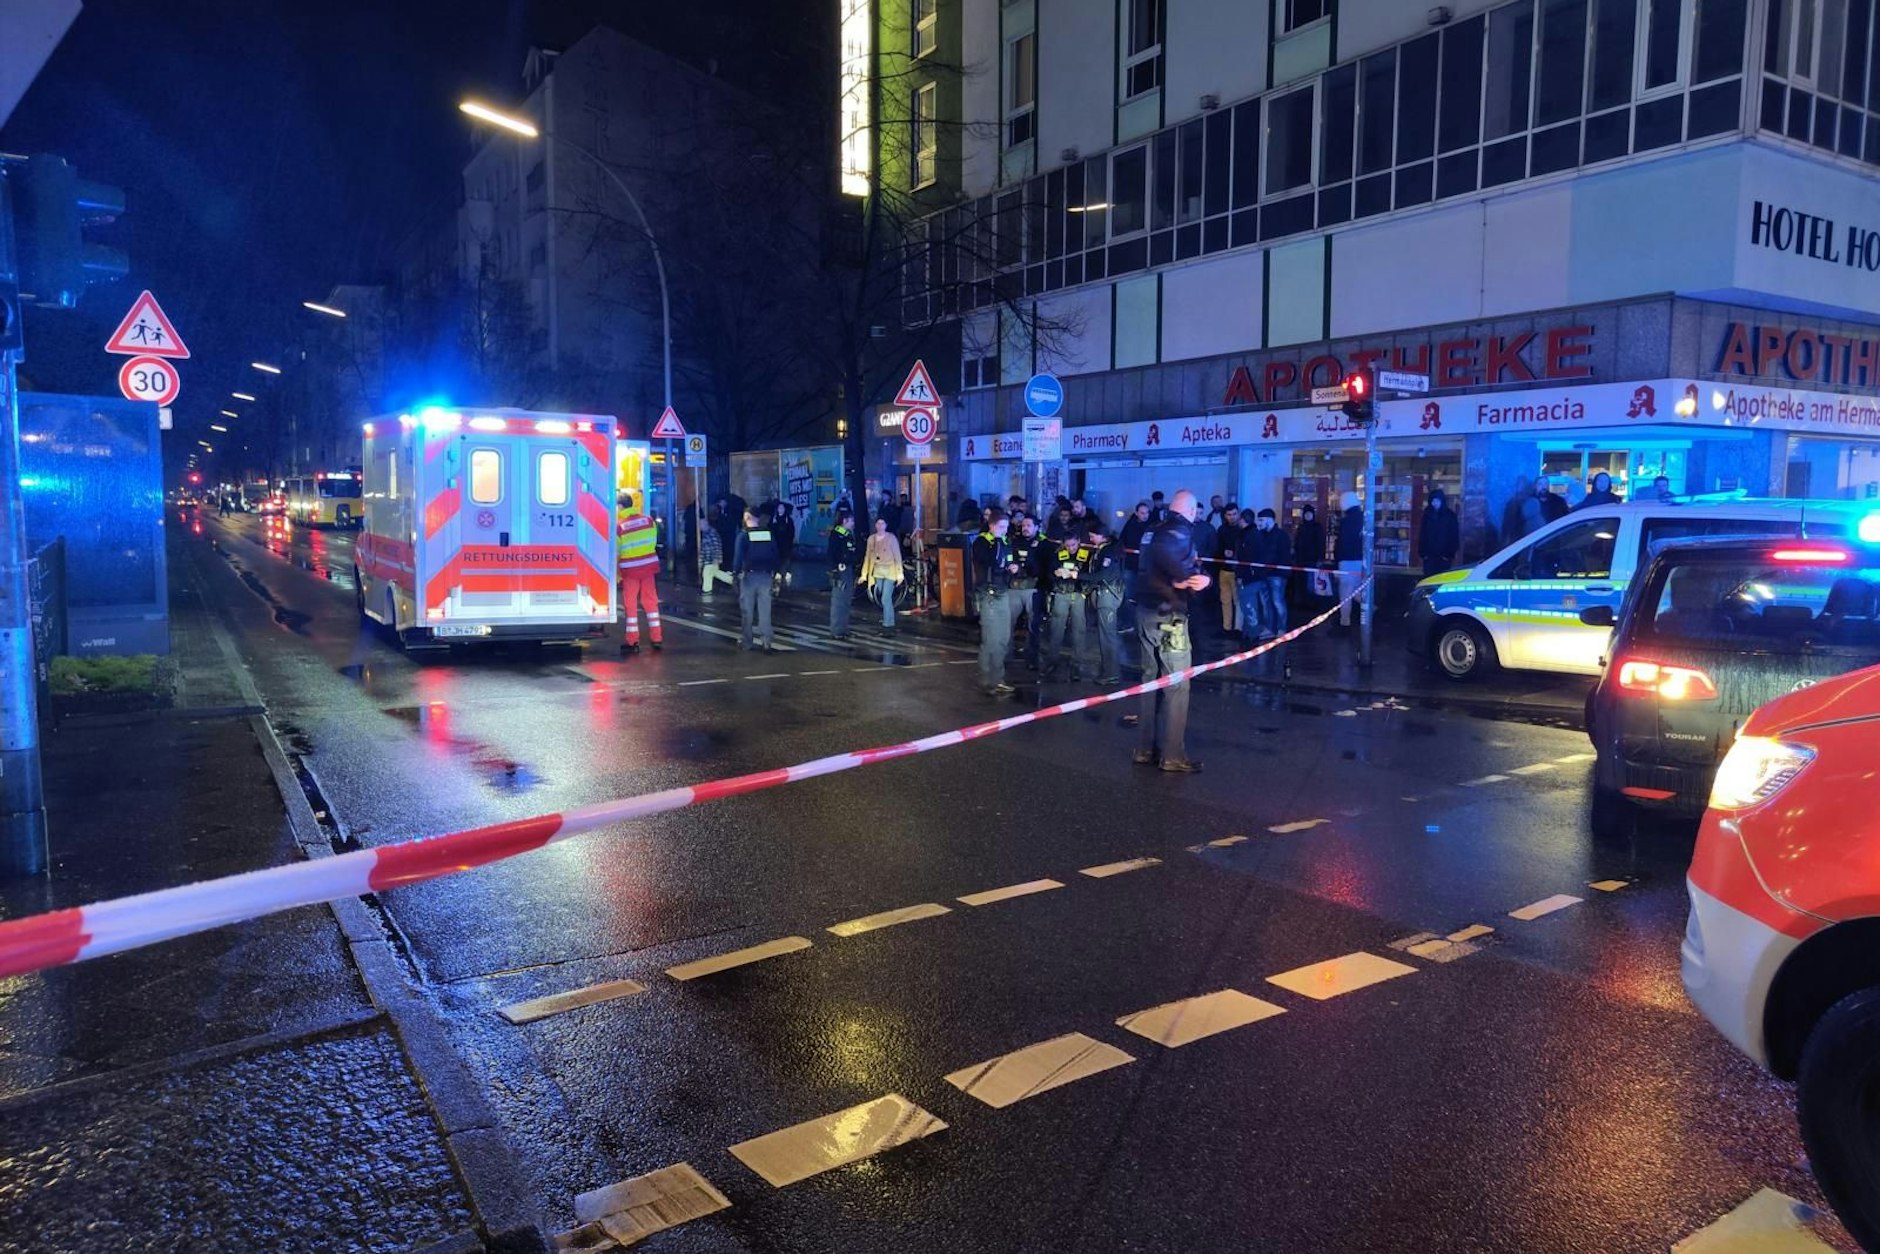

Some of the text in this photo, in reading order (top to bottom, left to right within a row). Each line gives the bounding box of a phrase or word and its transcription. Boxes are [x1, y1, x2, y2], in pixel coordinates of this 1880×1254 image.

[1751, 200, 1840, 264] HOTEL
[1223, 325, 1592, 404] APOTHEKE
[1719, 321, 1880, 388] APOTH
[133, 371, 167, 392] 30
[1476, 398, 1584, 425] Farmacia
[1724, 389, 1805, 422] Apotheke
[1810, 402, 1834, 423] am
[909, 417, 928, 433] 30
[1182, 421, 1232, 446] Apteka
[1073, 431, 1129, 453] Pharmacy
[548, 514, 575, 527] 112
[463, 551, 575, 562] RETTUNGSDIENST
[1663, 732, 1706, 742] TOURAN
